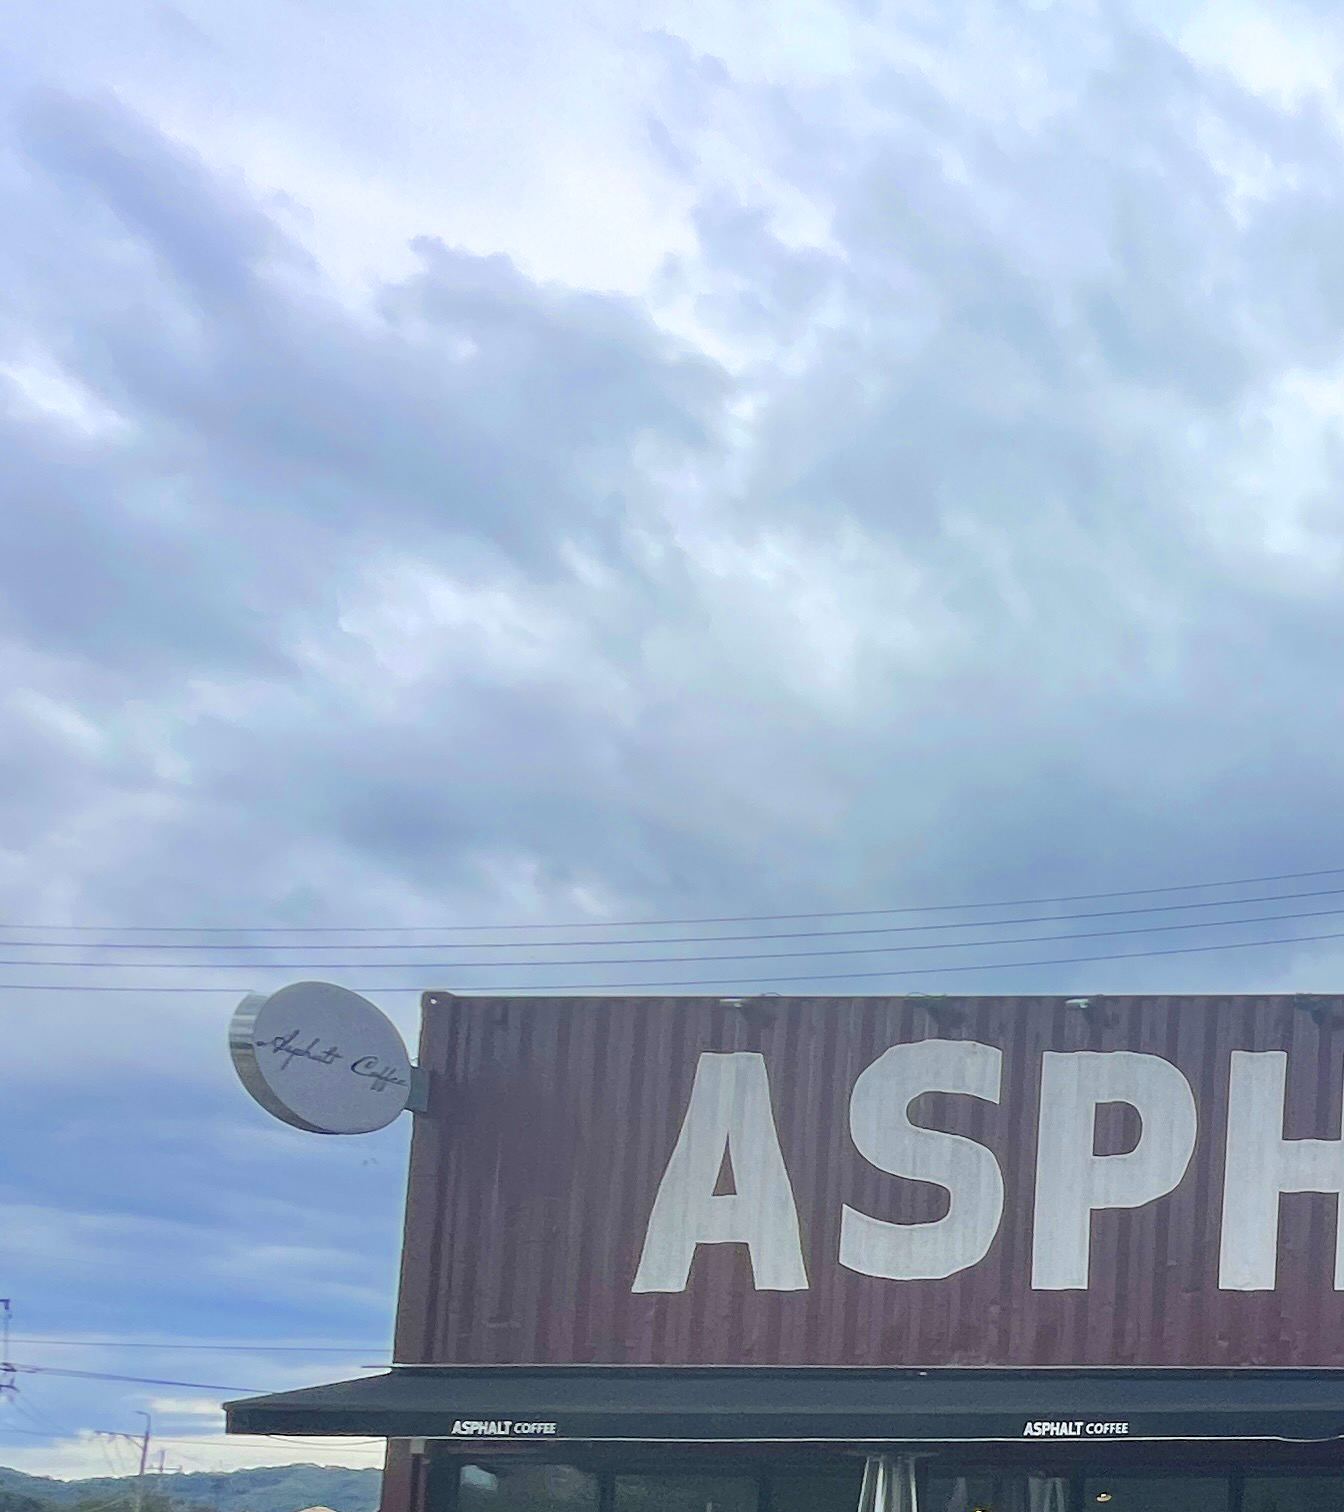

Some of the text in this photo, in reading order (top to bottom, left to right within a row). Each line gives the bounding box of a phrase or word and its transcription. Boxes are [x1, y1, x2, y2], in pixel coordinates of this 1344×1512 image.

[451, 1420, 557, 1435] ASPHALT COFFEE
[1023, 1421, 1129, 1436] ASPHALT COFFEE
